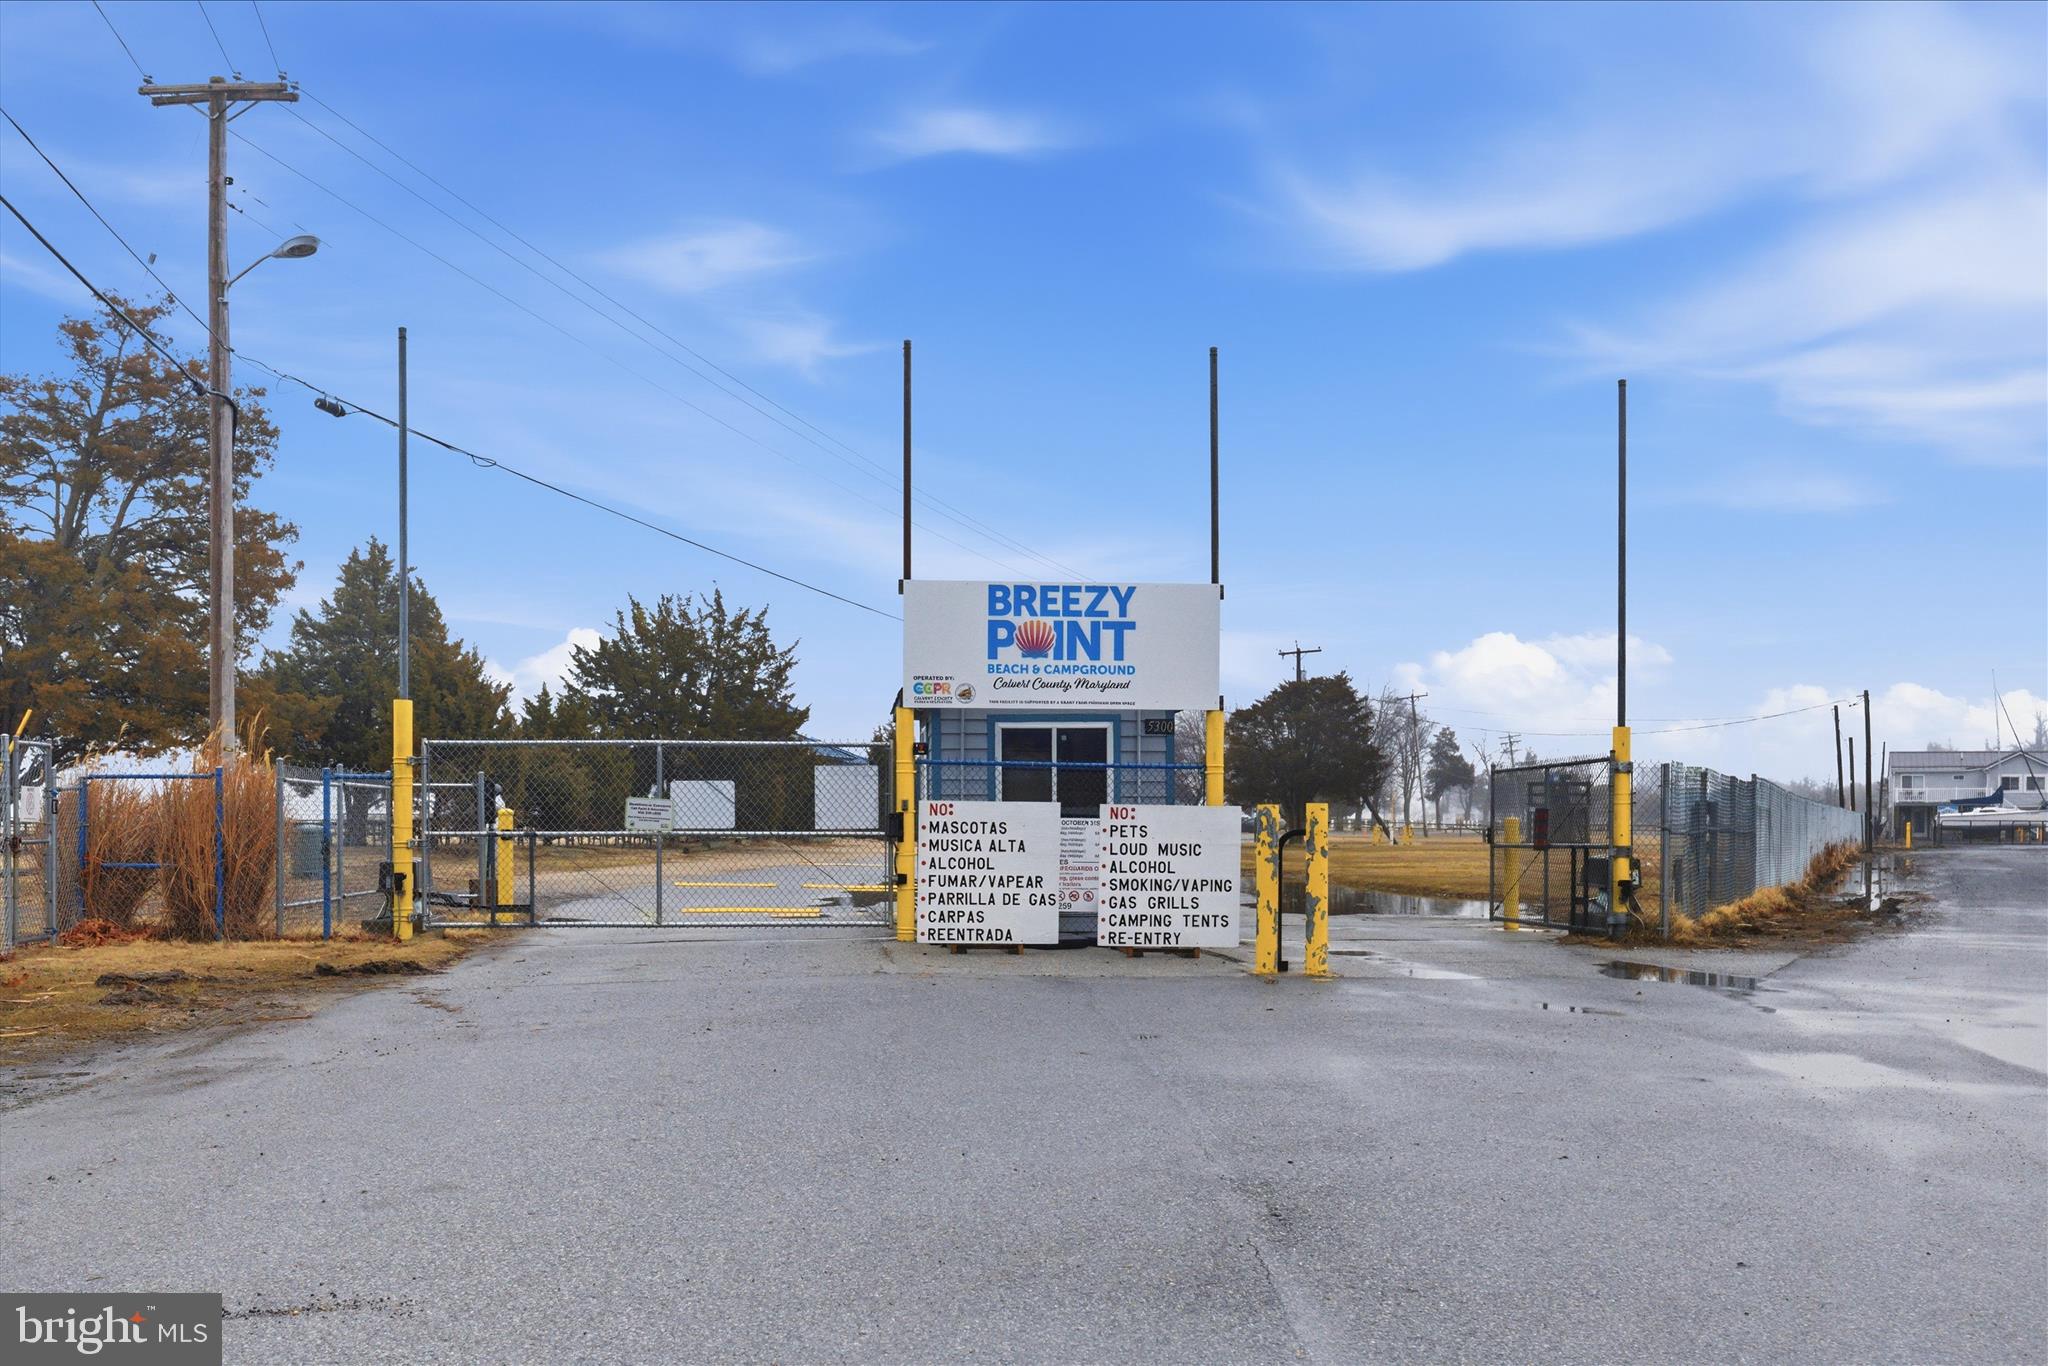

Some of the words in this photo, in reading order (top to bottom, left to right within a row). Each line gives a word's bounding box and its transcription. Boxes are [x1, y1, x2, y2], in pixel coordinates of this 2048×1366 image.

[987, 584, 1137, 618] BREEZY
[987, 663, 1029, 675] BEACH
[1032, 664, 1041, 675] &
[1044, 664, 1136, 676] CAMPGROUND
[913, 681, 952, 696] CCPR
[993, 676, 1031, 690] Calvert
[1031, 677, 1072, 693] County,
[1073, 677, 1131, 693] Maryland
[1147, 720, 1174, 733] 5300
[929, 803, 953, 816] NO:
[1110, 807, 1136, 820] NO:
[929, 821, 1007, 835] MASCOTAS
[1110, 825, 1148, 838] PETS
[929, 838, 982, 852] MUSICA
[988, 839, 1026, 853] ALTA
[1109, 843, 1148, 856] LOUD
[1158, 843, 1202, 857] MUSIC
[929, 856, 995, 870] ALCOHOL
[1109, 861, 1176, 874] ALCOHOL
[928, 875, 1044, 889] FUMAR/VAPEAR
[1109, 878, 1233, 893] SMOKING/VAPING
[928, 892, 996, 906] PARRILLA
[1002, 893, 1021, 906] DE
[1028, 893, 1057, 907] GAS
[1109, 896, 1137, 909] GAS
[1147, 896, 1200, 910] GRILLS
[928, 910, 985, 924] CARPAS
[1108, 914, 1172, 928] CAMPING
[1182, 914, 1229, 928] TENTS
[927, 928, 1013, 942] REENTRADA
[1107, 932, 1181, 946] RE-ENTRY
